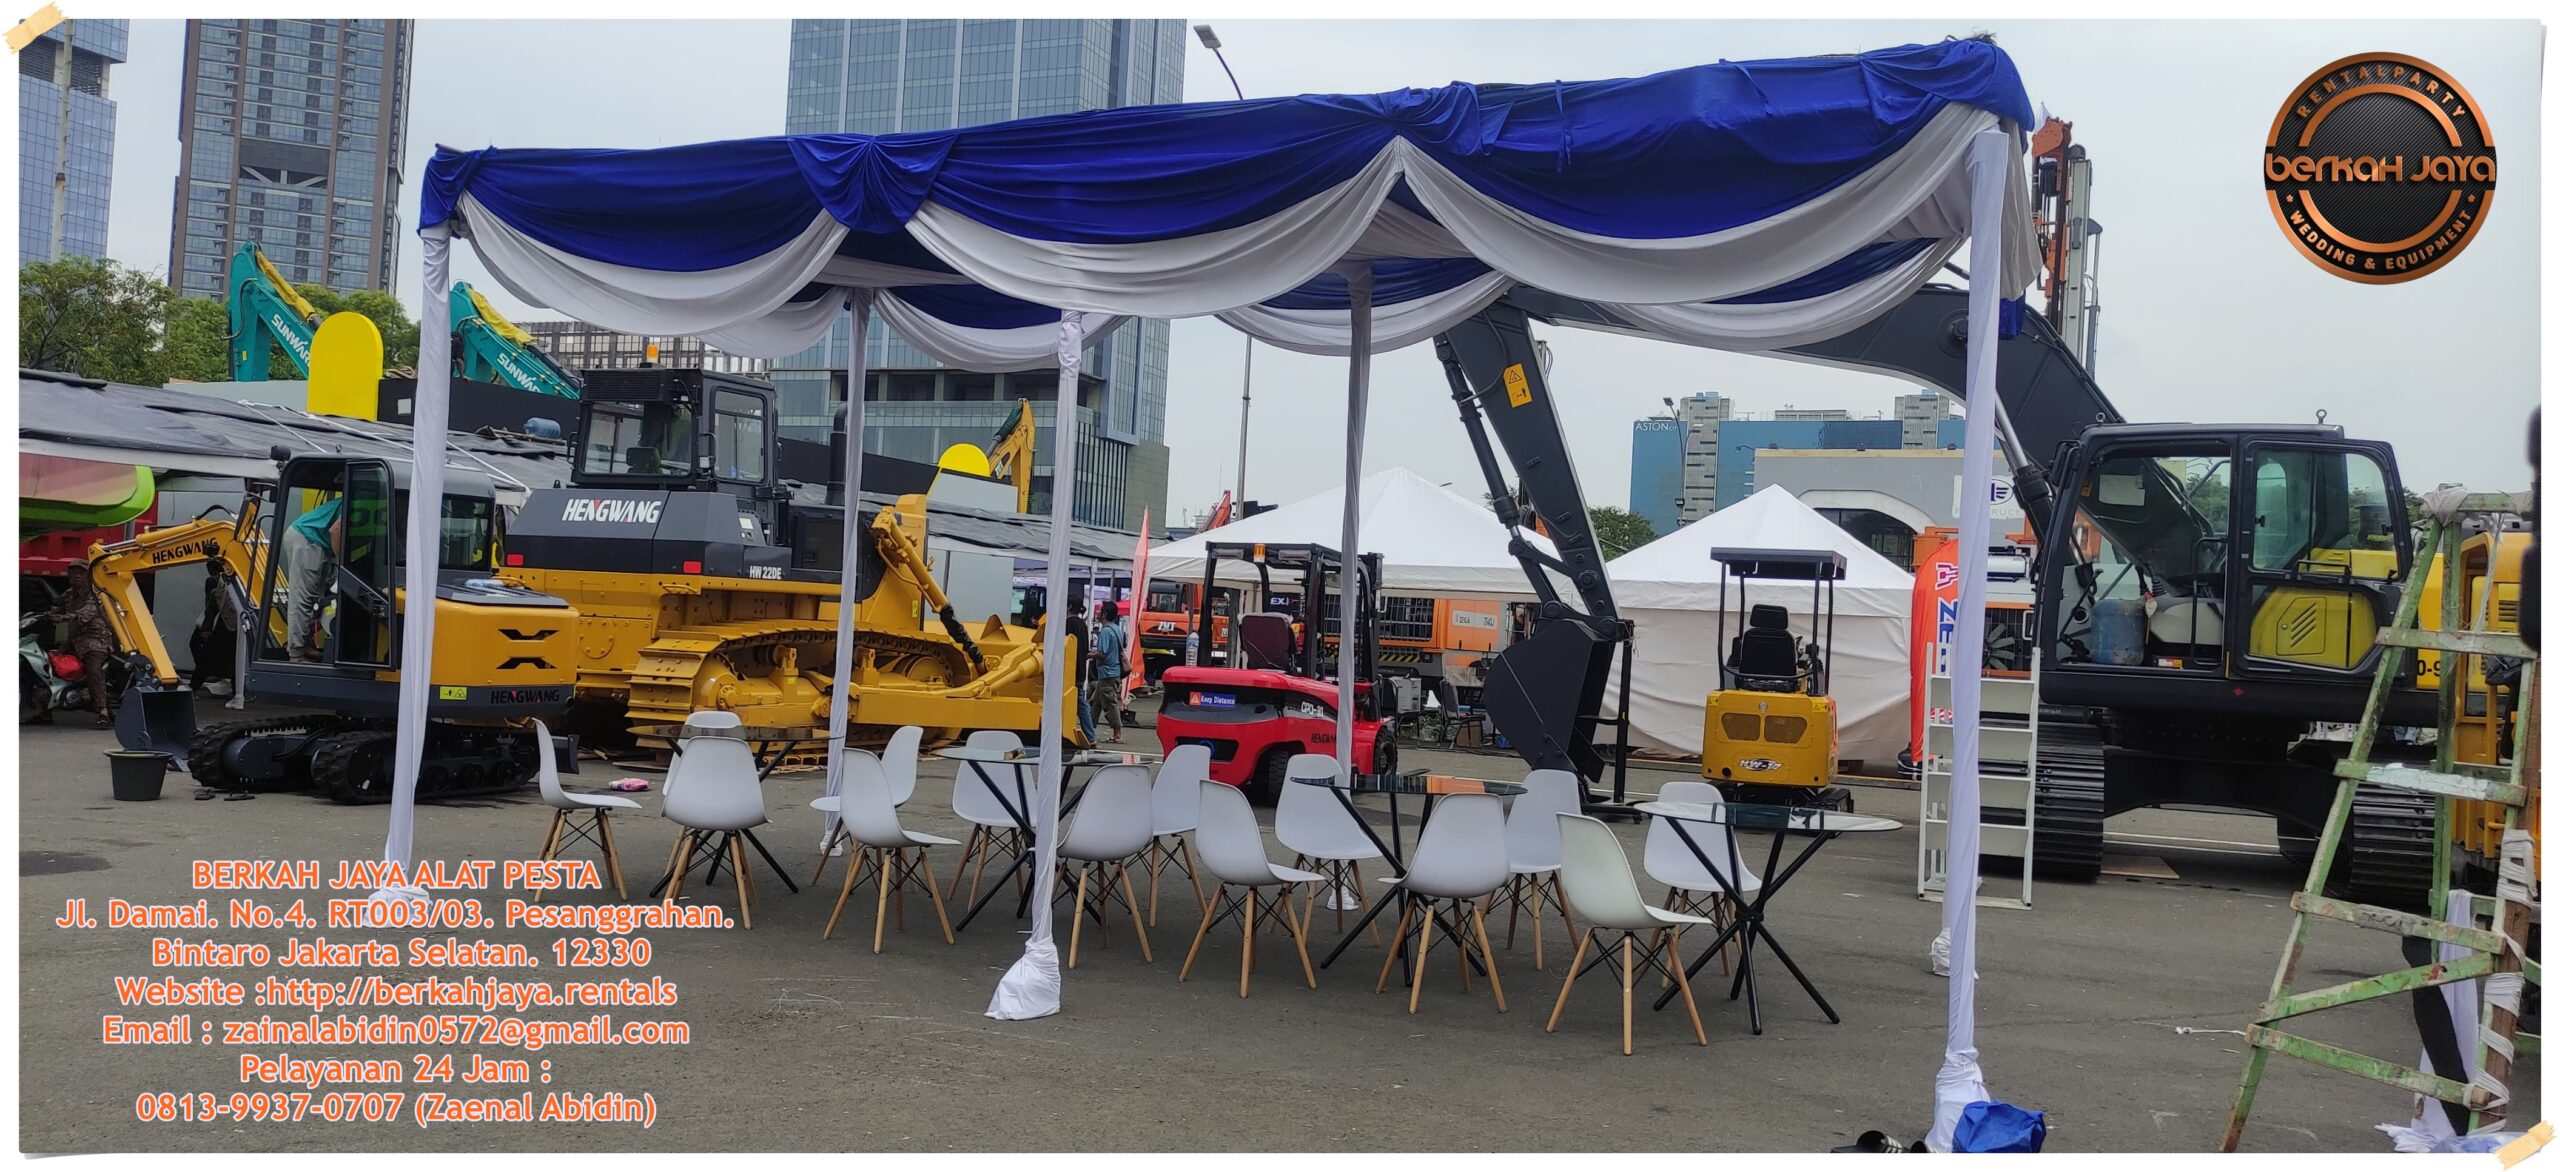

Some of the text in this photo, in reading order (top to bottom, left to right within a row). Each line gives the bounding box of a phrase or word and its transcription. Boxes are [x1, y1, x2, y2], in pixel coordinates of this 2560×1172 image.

[1635, 422, 1669, 431] ASTON
[561, 498, 662, 523] HENGWANG
[750, 565, 762, 579] HW
[490, 689, 560, 704] HENGWANG
[1201, 695, 1236, 705] Keep Distance
